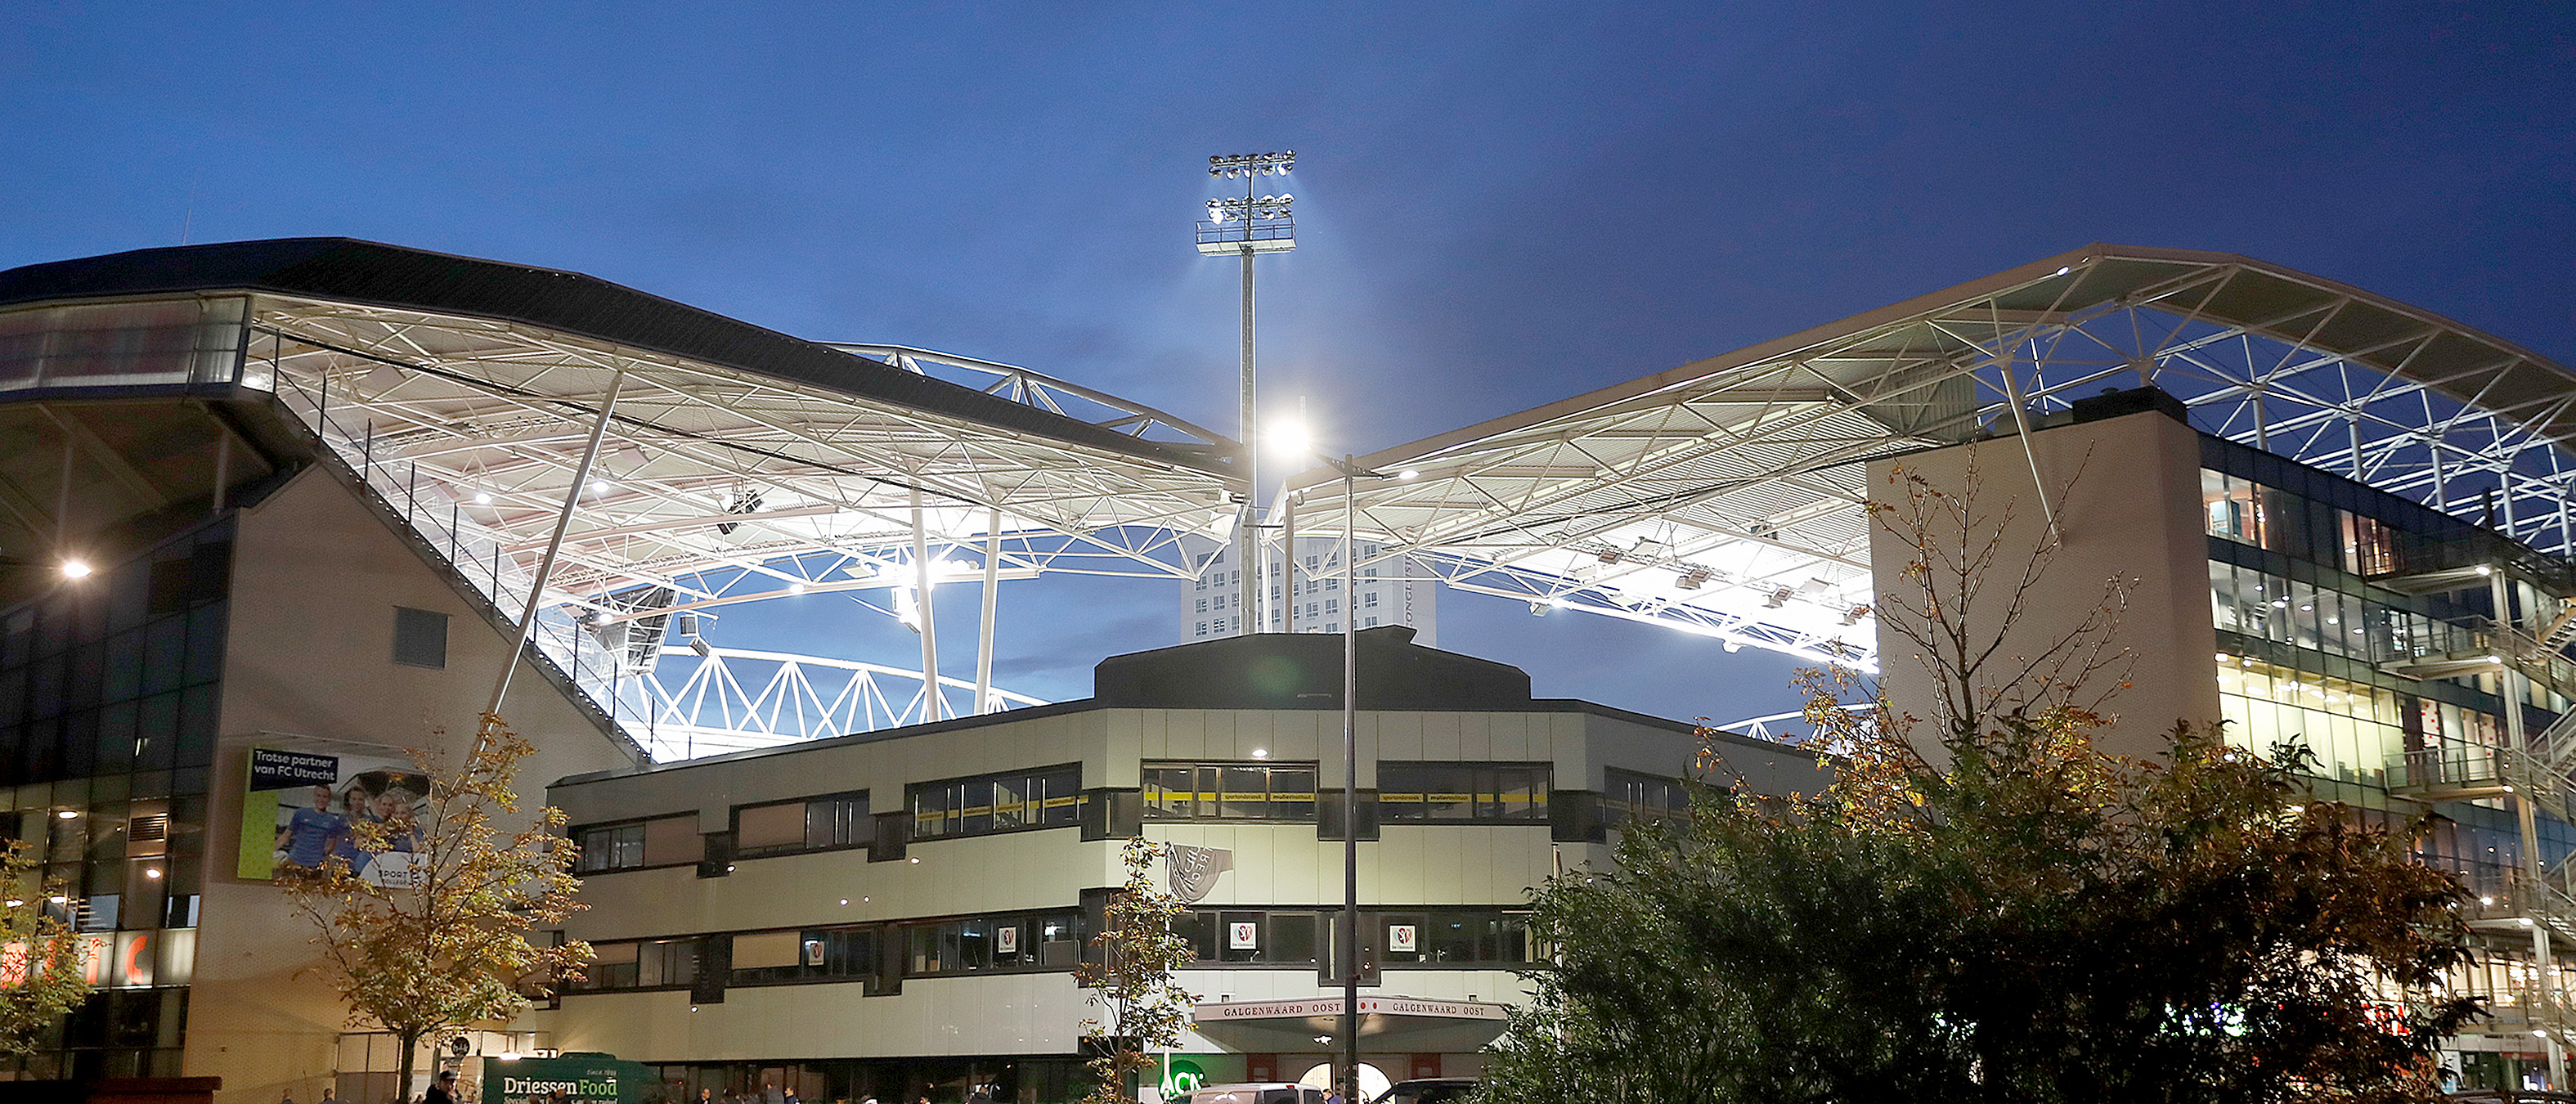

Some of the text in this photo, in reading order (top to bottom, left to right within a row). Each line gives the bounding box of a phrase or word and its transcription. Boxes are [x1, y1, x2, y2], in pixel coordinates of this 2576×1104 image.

[256, 751, 333, 768] Trotse partner
[254, 765, 335, 781] van FC Utrecht
[1224, 1003, 1340, 1016] GALGENWAARD OOST
[1393, 1003, 1484, 1015] GALGENWAARD OOST
[504, 1076, 617, 1095] Driessen Food
